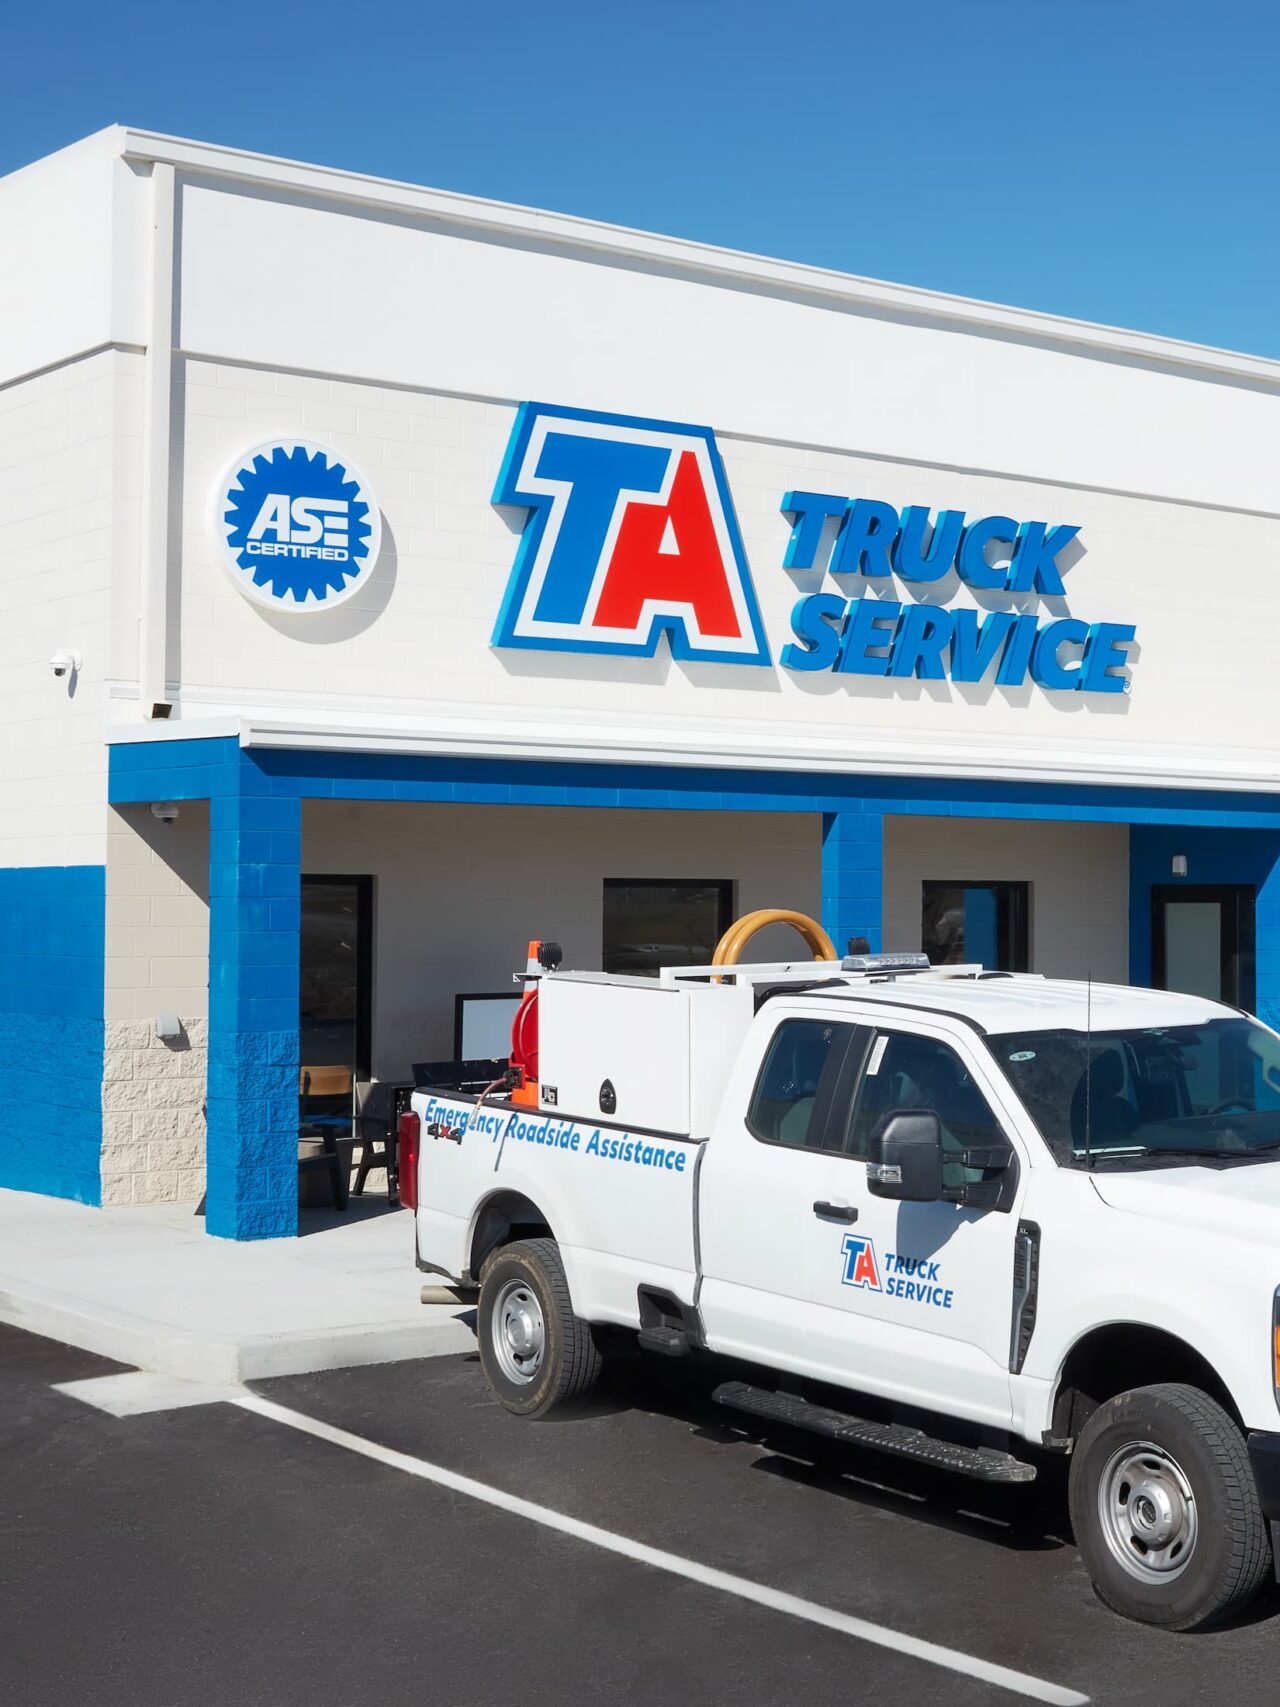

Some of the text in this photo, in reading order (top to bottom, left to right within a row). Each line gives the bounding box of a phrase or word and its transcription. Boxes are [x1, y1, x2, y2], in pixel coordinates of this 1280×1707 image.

[247, 493, 349, 547] ASE
[510, 412, 762, 656] TA
[780, 491, 1082, 595] TRUCK
[246, 541, 349, 562] CERTIFIED
[780, 593, 1137, 693] SERVICE
[506, 1112, 580, 1152] Roadside
[585, 1129, 687, 1172] Assistance
[843, 1236, 880, 1290] TA
[885, 1252, 941, 1282] TRUCK
[885, 1277, 954, 1309] SERVICE
